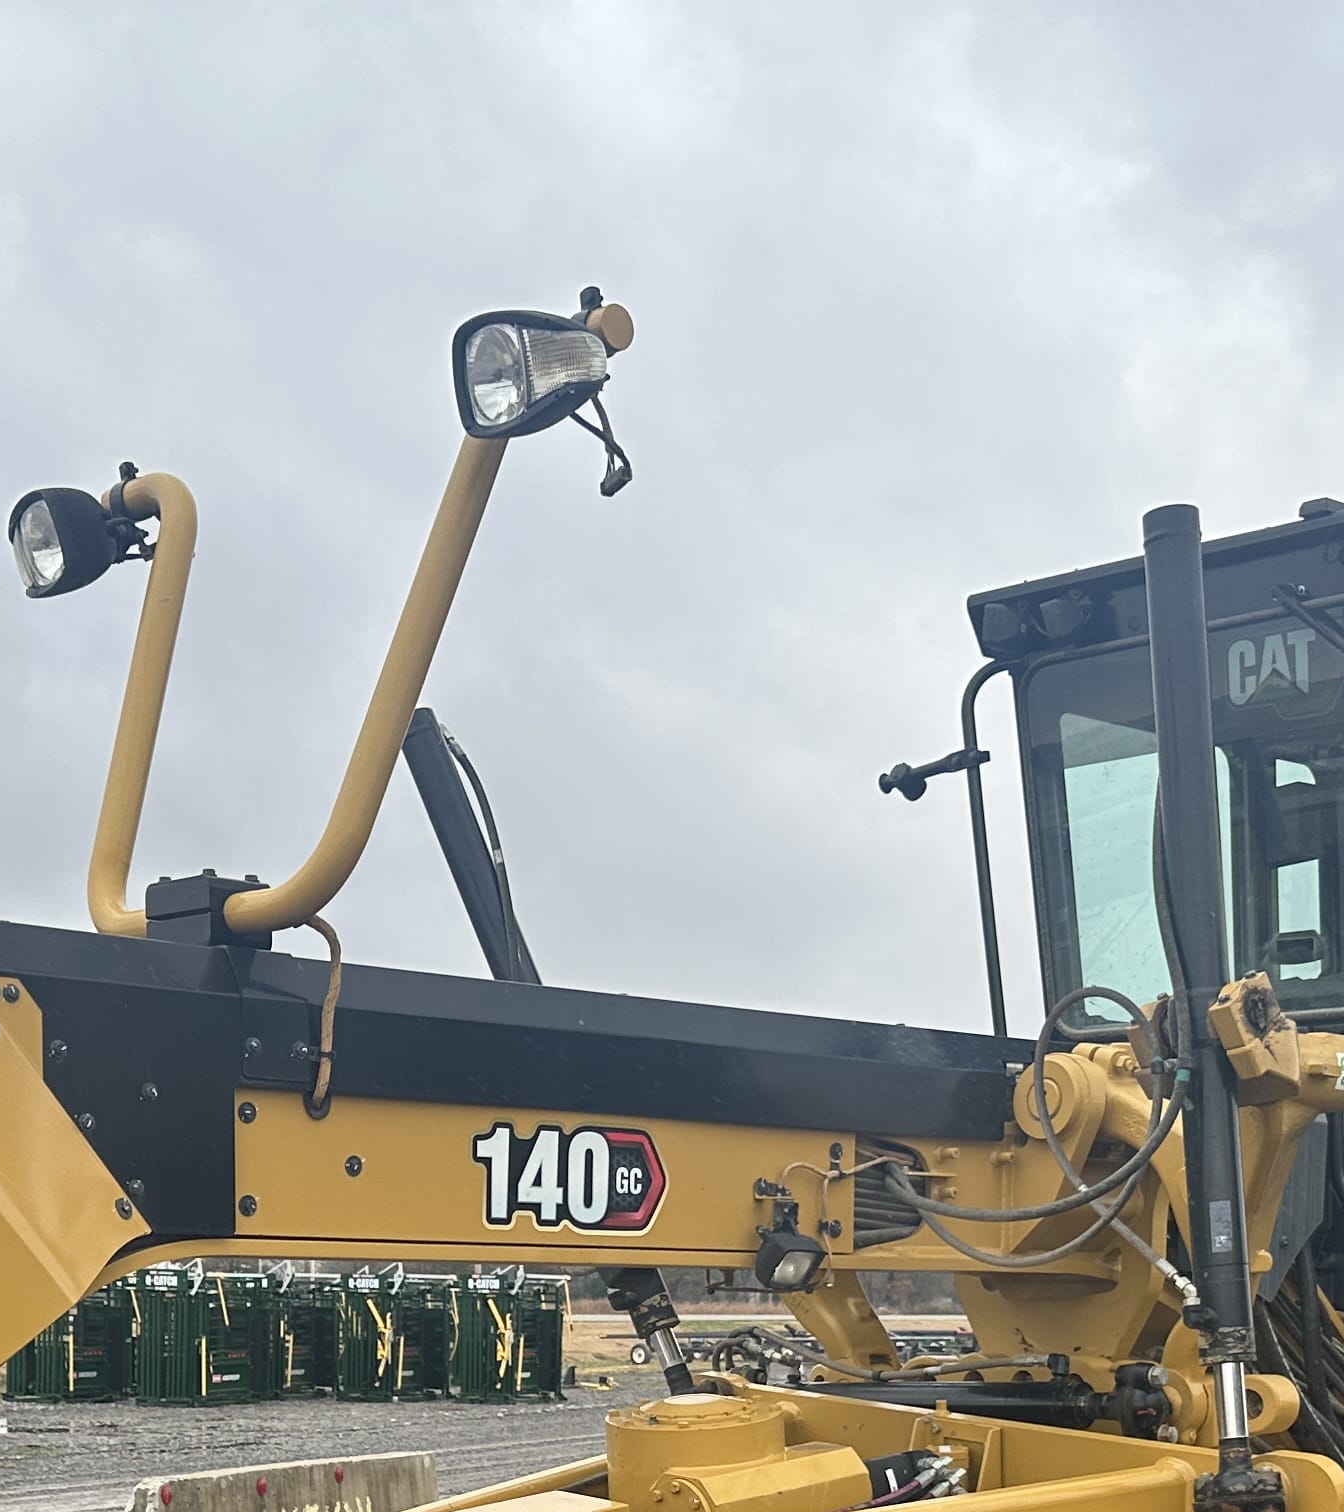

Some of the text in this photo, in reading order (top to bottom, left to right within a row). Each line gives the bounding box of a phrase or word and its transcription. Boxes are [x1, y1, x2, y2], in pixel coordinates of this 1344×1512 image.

[1228, 629, 1316, 705] CAT
[475, 1126, 643, 1225] 140 GC
